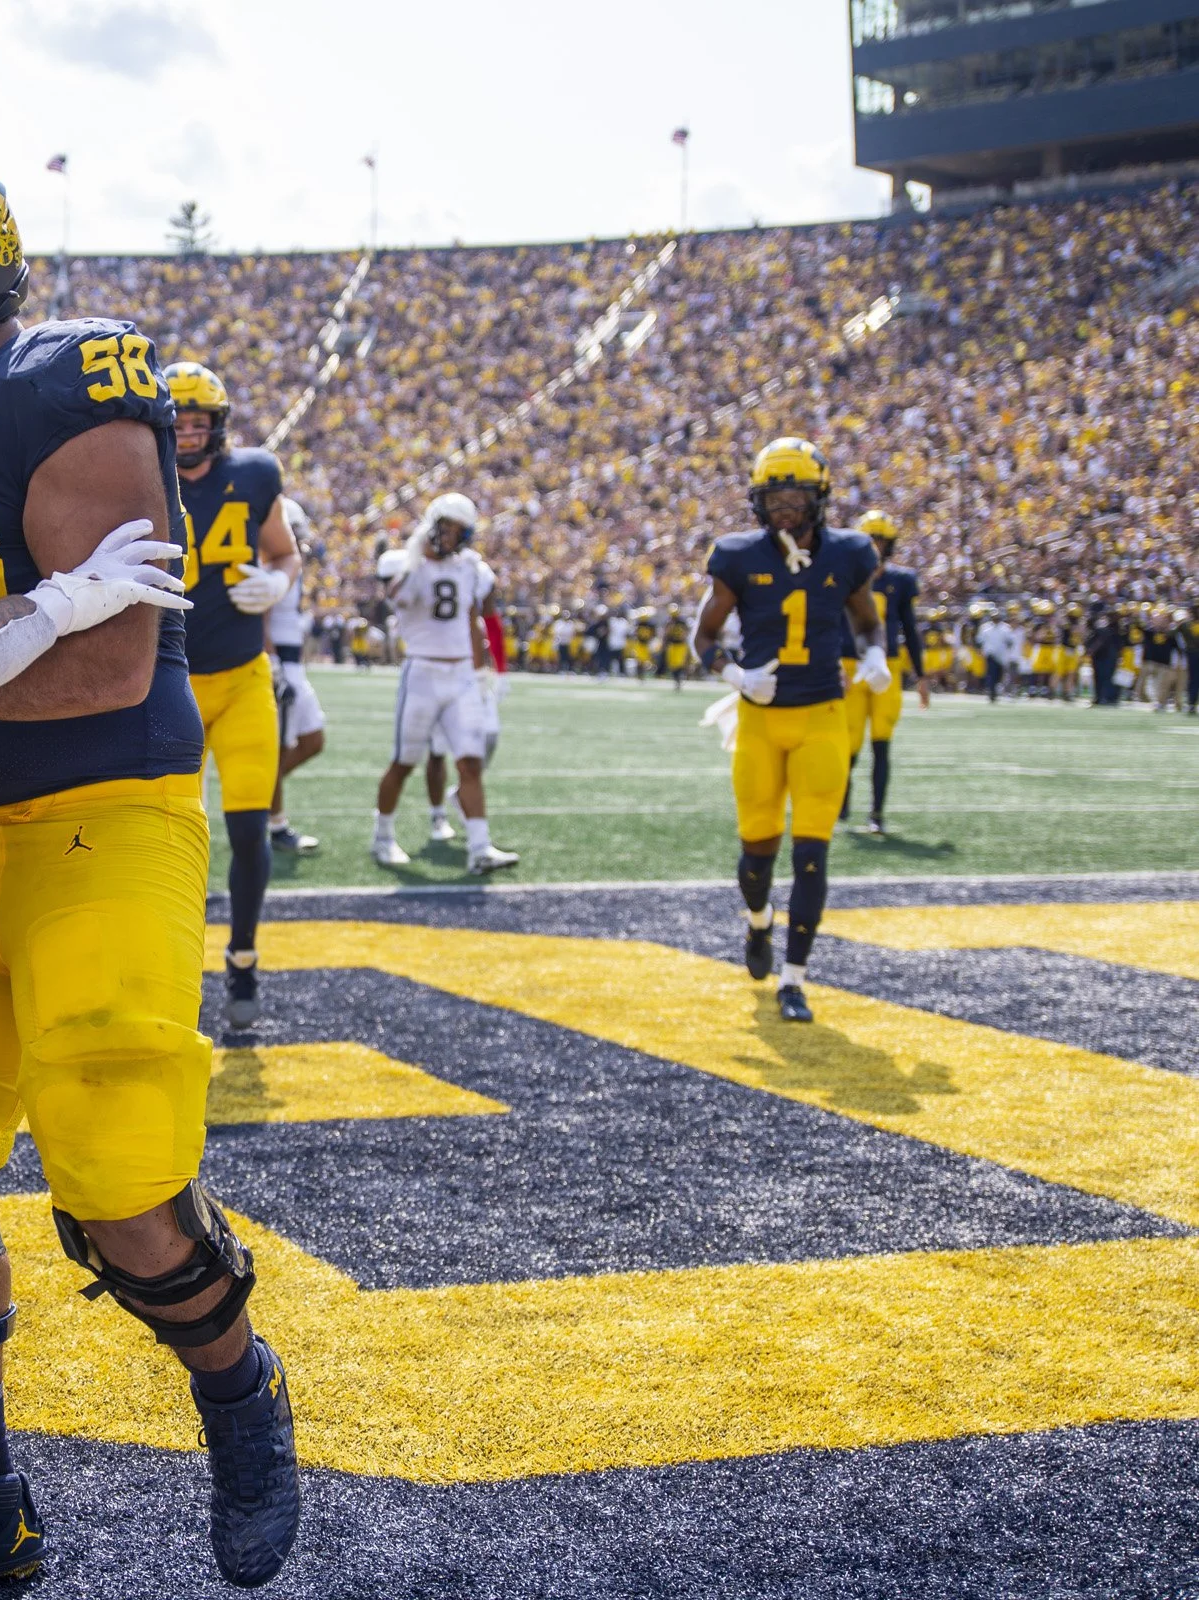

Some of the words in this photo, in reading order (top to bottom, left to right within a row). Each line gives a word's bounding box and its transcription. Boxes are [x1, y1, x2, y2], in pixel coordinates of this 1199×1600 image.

[79, 334, 158, 402] 58
[433, 580, 458, 620] 8
[778, 589, 810, 665] 1
